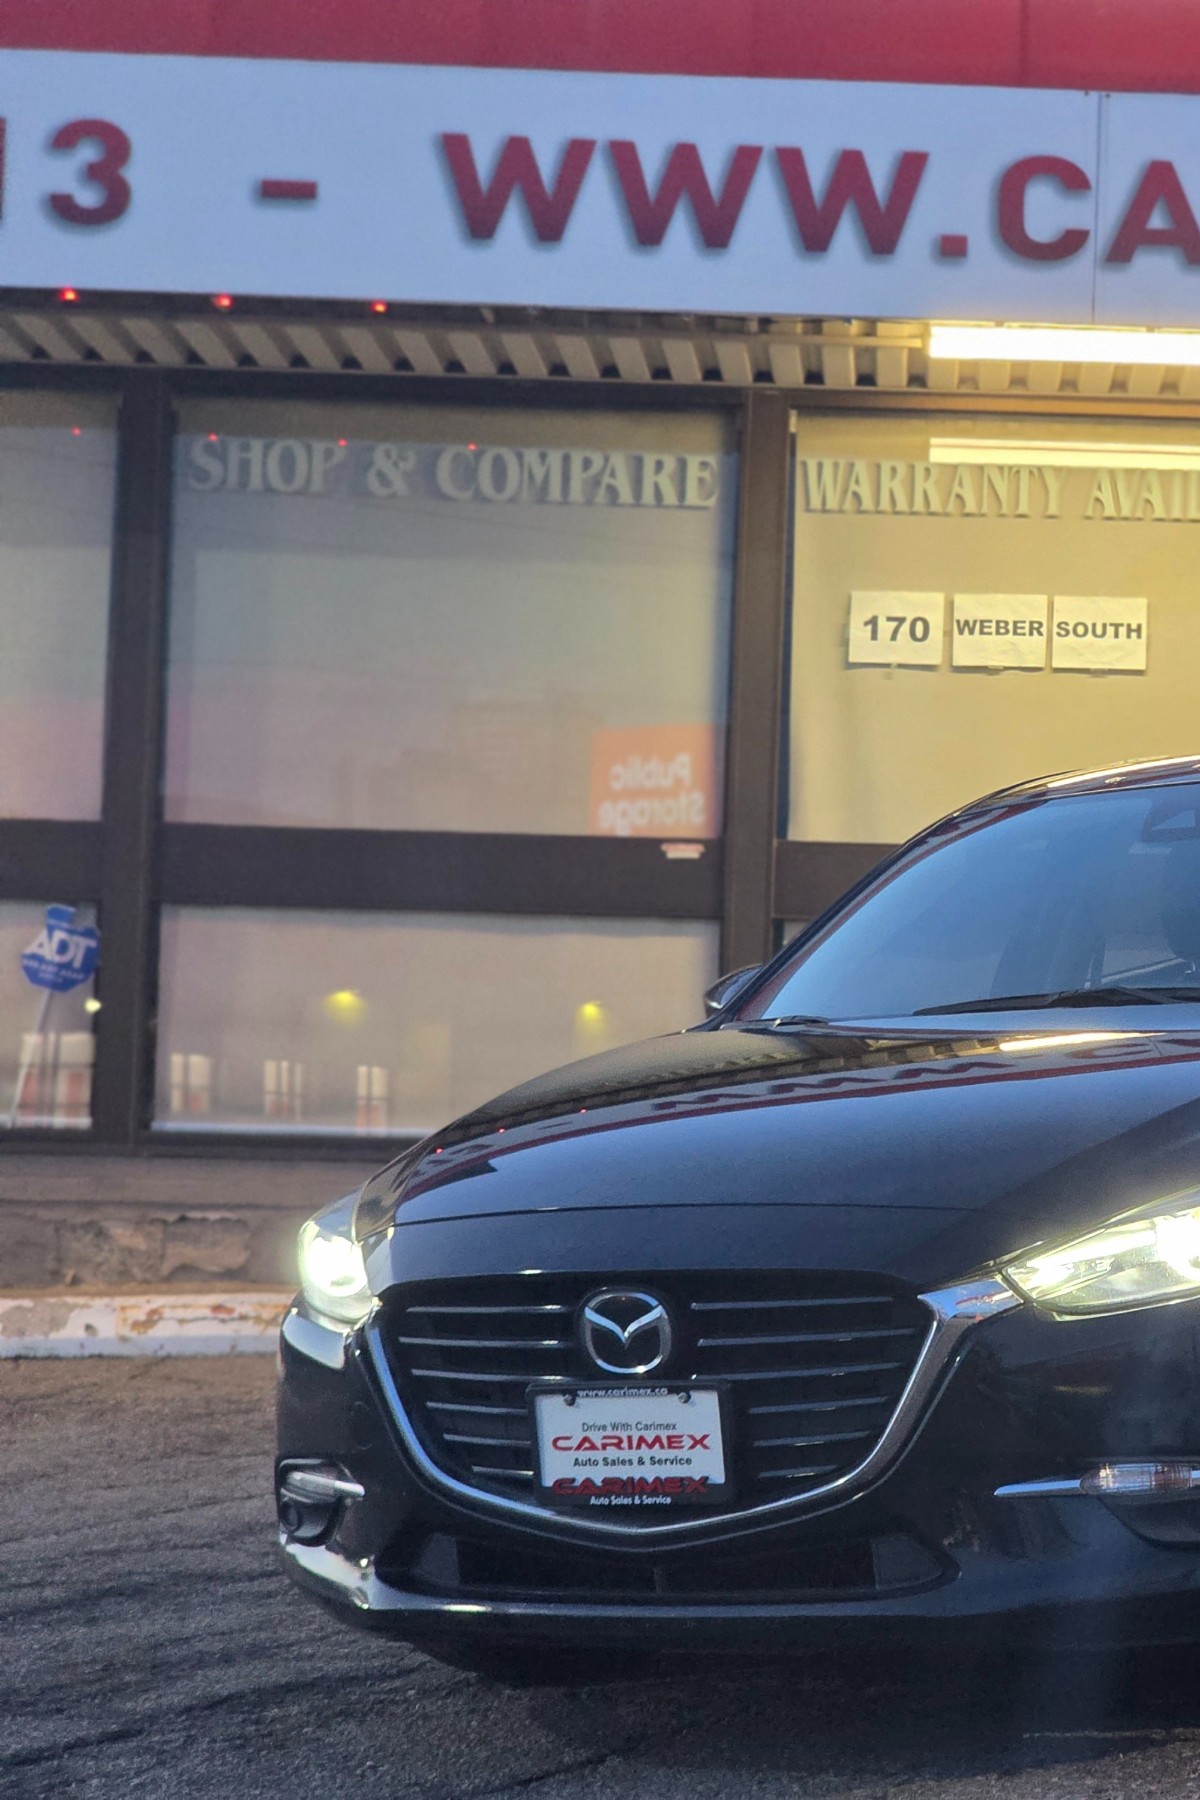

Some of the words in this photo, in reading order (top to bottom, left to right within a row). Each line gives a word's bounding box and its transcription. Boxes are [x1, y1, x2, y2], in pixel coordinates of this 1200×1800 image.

[0, 115, 133, 227] 3
[190, 437, 345, 493] SHOP
[366, 443, 416, 497] &
[436, 446, 718, 507] COMPARE
[800, 459, 1062, 517] WARRANTY
[863, 615, 930, 642] 170
[956, 619, 1044, 637] WEBER
[1055, 621, 1143, 639] SOUTH
[23, 928, 98, 969] ADT
[582, 1422, 607, 1432] Drive
[610, 1421, 633, 1431] With
[635, 1420, 677, 1431] Carimex
[551, 1433, 711, 1452] CARIMEX
[573, 1456, 600, 1467] Auto
[602, 1455, 633, 1467] Sales
[637, 1456, 646, 1466] &
[650, 1455, 692, 1466] Service
[551, 1476, 709, 1495] CARIMEX
[589, 1496, 610, 1506] Auto
[611, 1495, 633, 1505] Sales
[642, 1494, 672, 1504] Service
